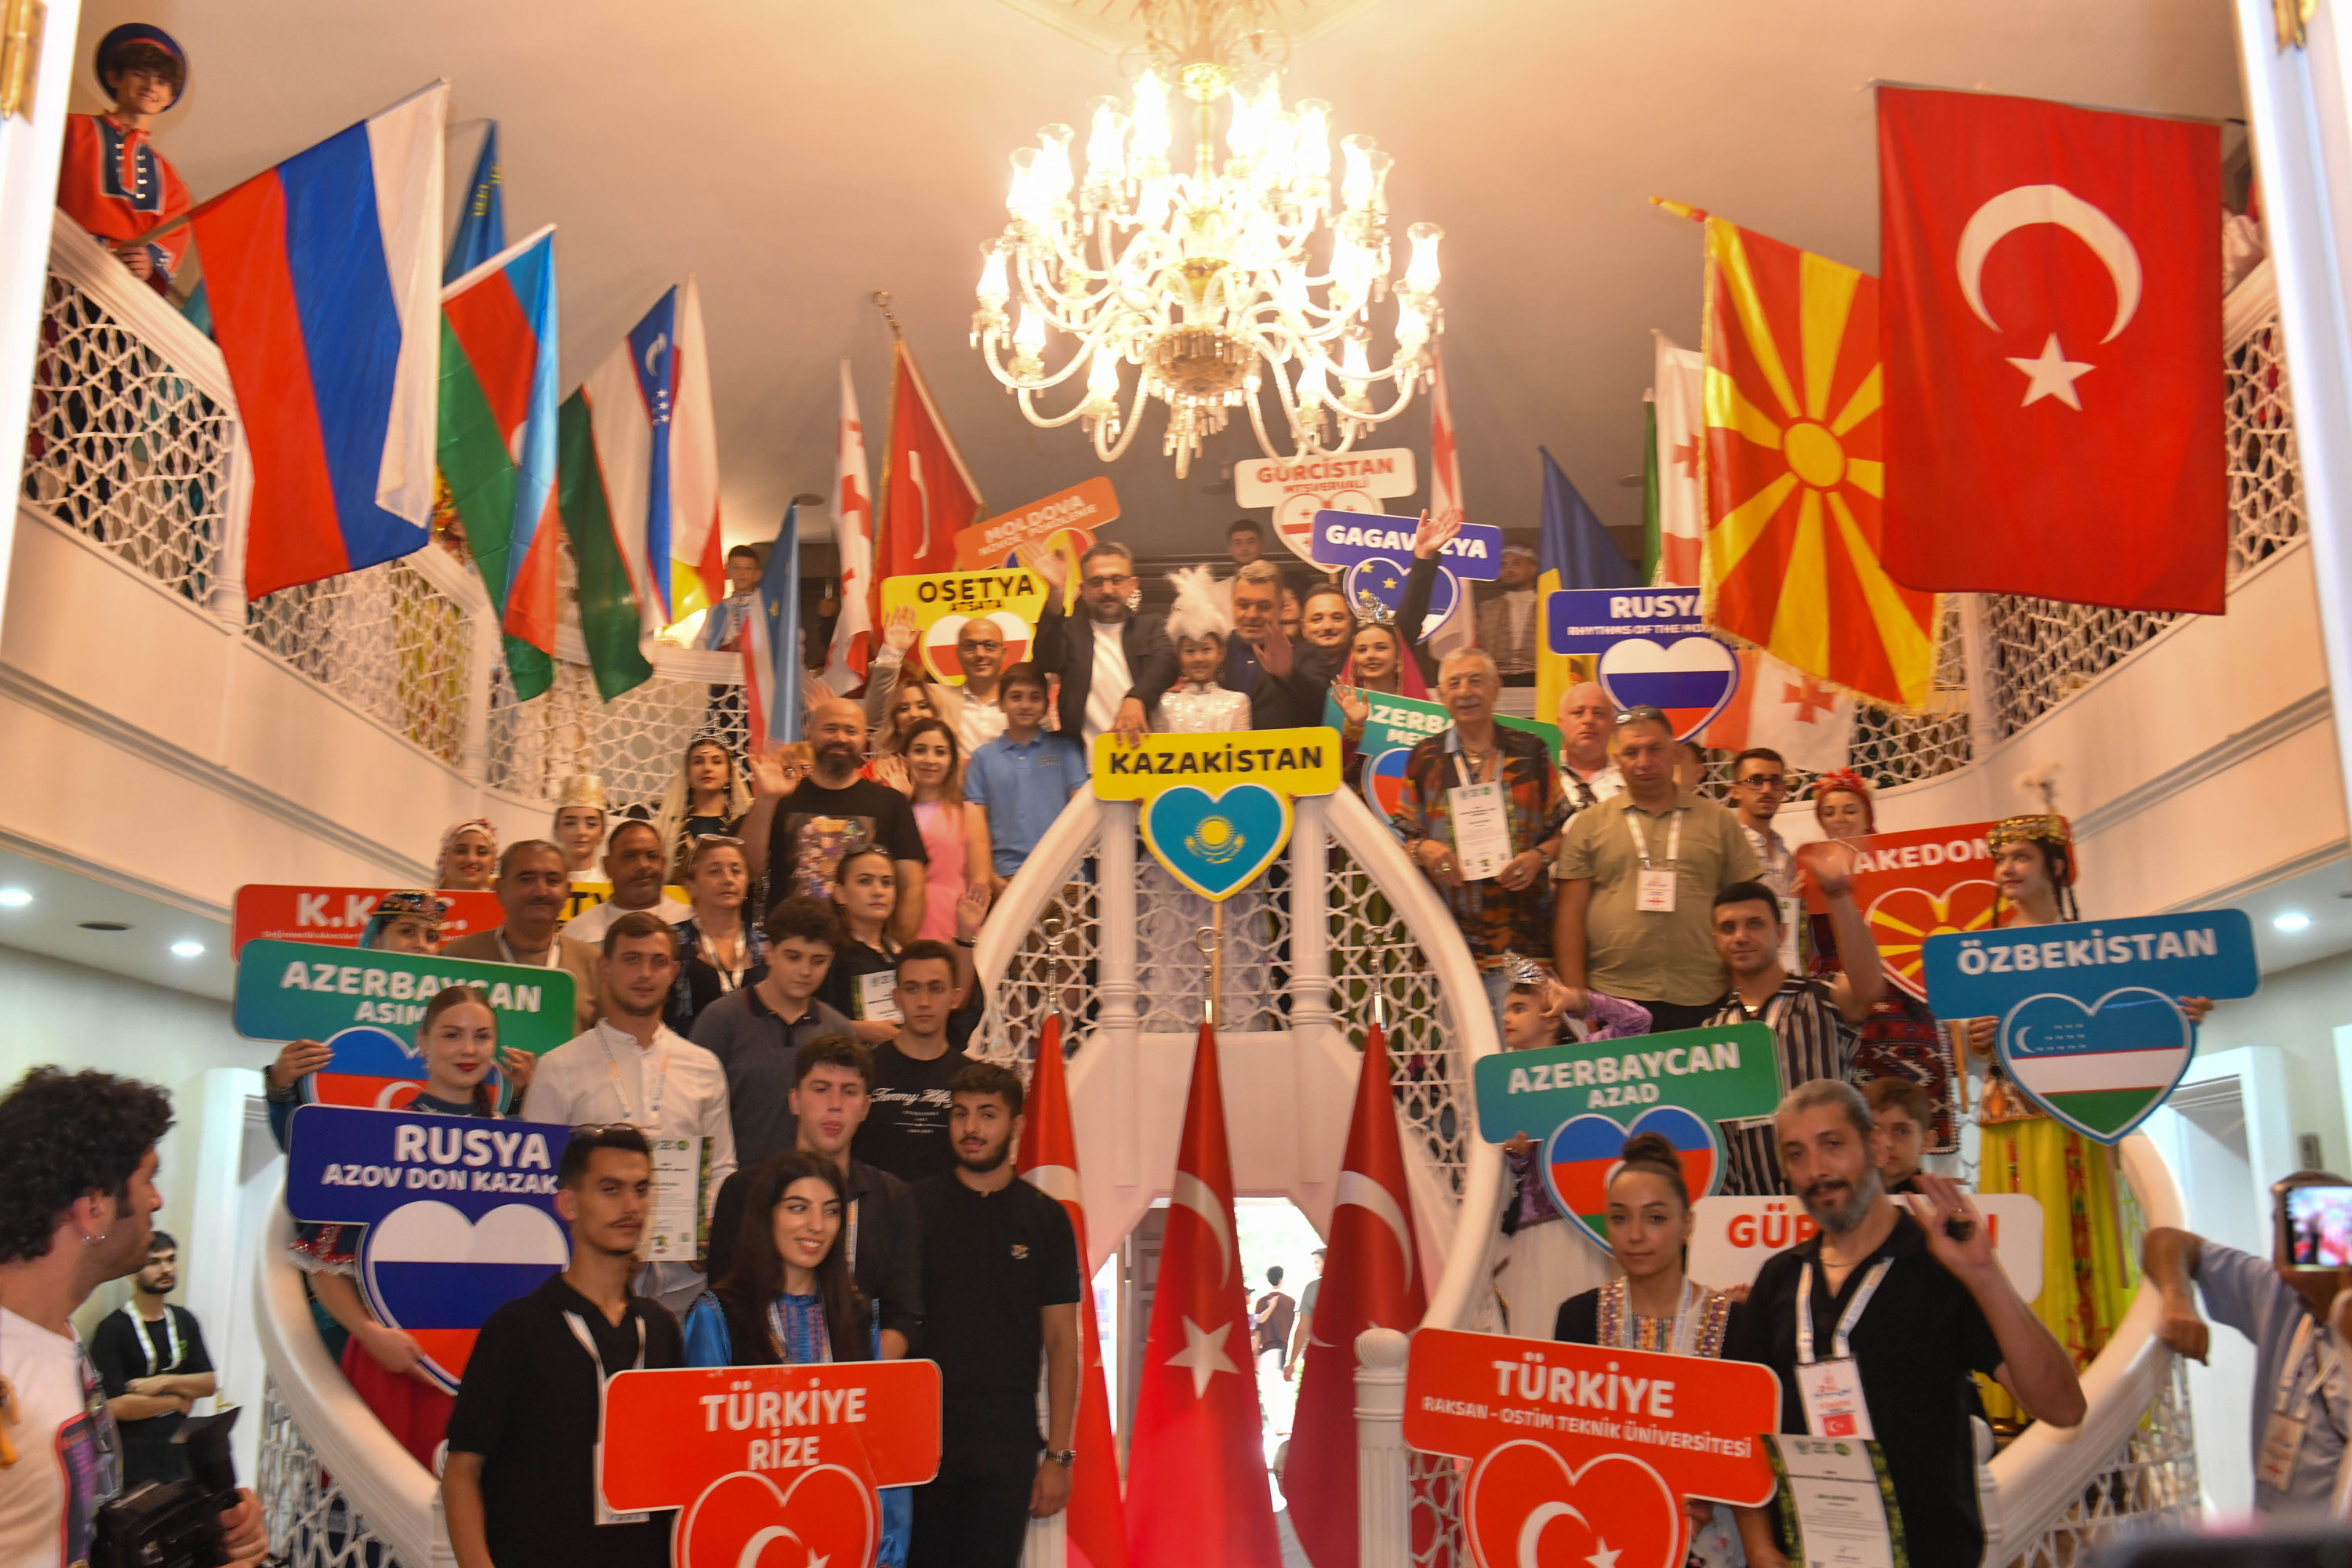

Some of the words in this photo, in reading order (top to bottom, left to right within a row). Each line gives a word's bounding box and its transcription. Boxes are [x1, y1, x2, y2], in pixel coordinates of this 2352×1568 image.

[983, 495, 1085, 543] MOLDOVA
[918, 575, 1034, 603] OSETYA
[1109, 742, 1323, 775] KAZAKİSTAN
[1957, 928, 2218, 975] ÖZBEKİSTAN
[1508, 1042, 1740, 1094] AZERBAYCAN
[1587, 1083, 1661, 1109] AZAD
[394, 1124, 552, 1170] RUSYA
[321, 1163, 402, 1188] AZOV
[405, 1168, 468, 1191] DON
[471, 1171, 559, 1195] KAZAK
[699, 1377, 867, 1432] TÜRKİYE
[1491, 1350, 1676, 1419] TÜRKİYE
[747, 1428, 820, 1471] RİZE
[1421, 1396, 1489, 1420] RAKSAN
[1498, 1406, 1555, 1430] OSTİM
[1557, 1415, 1621, 1439] TEKNİK
[1623, 1420, 1753, 1460] ÜNİVERSİTESİ
